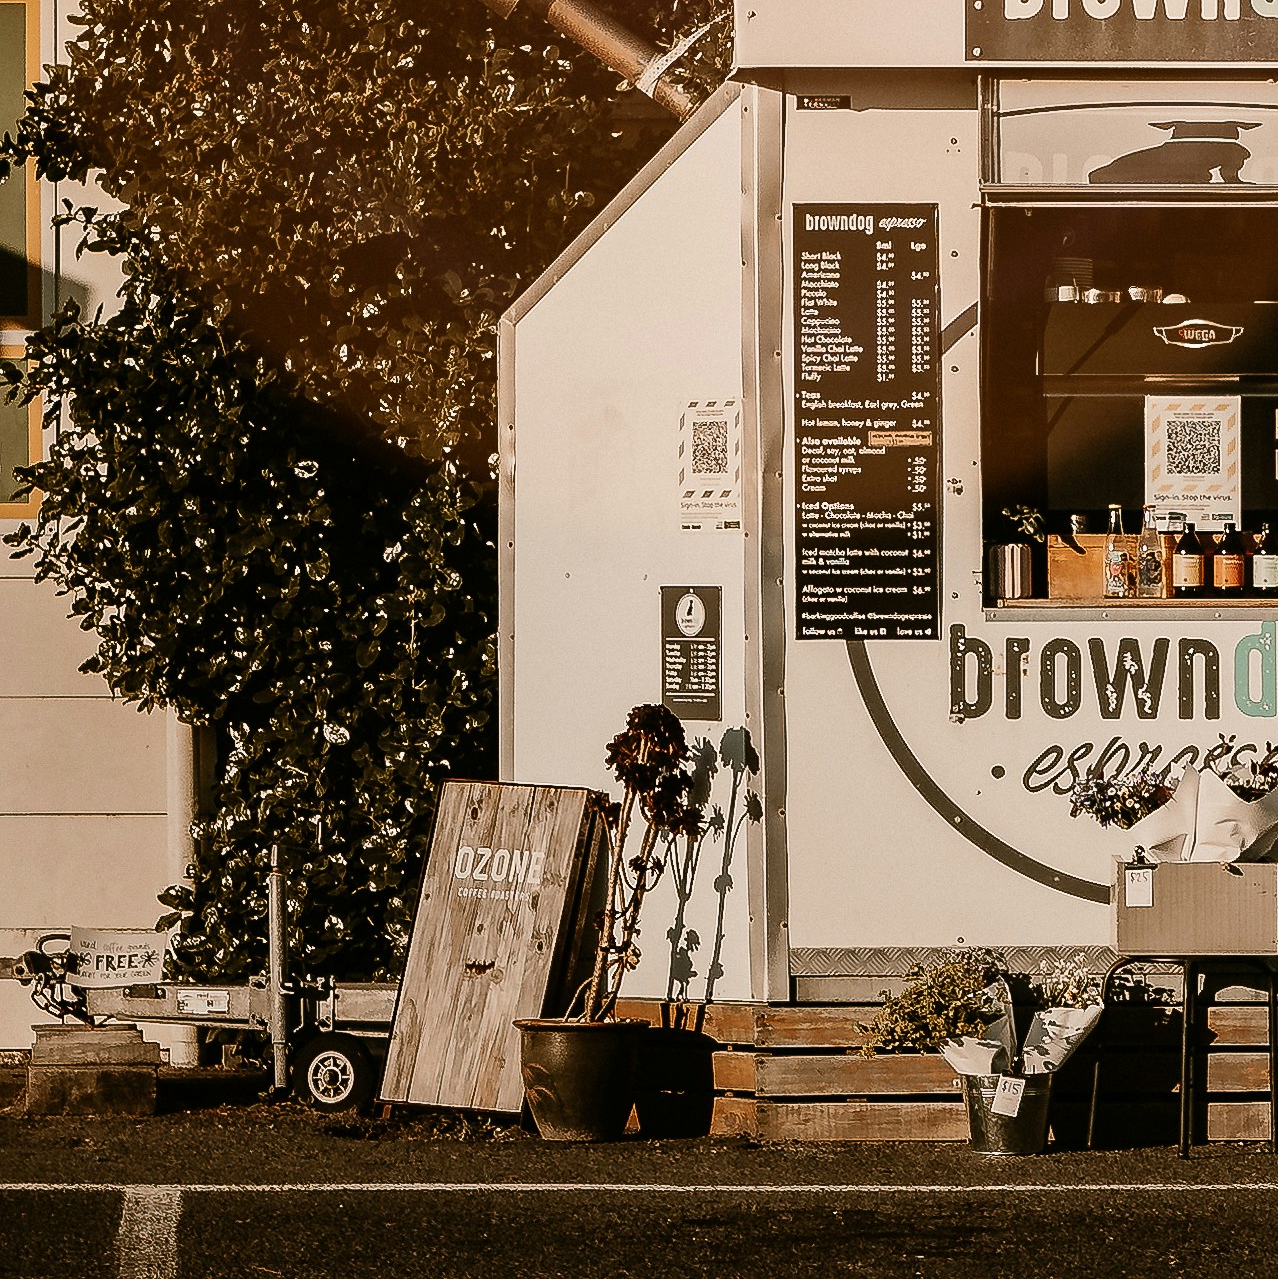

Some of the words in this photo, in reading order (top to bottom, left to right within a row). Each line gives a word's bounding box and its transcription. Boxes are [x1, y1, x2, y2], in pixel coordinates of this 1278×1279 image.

[806, 214, 874, 236] browndog
[801, 335, 815, 343] Hot
[1184, 329, 1216, 341] WEGA
[802, 436, 821, 445] Also
[1182, 494, 1199, 502] Stop
[454, 846, 546, 884] OZONE
[457, 886, 489, 899] COFFEE
[102, 942, 124, 953] coffee
[95, 953, 139, 972] FREE
[1001, 1080, 1022, 1096] $15
